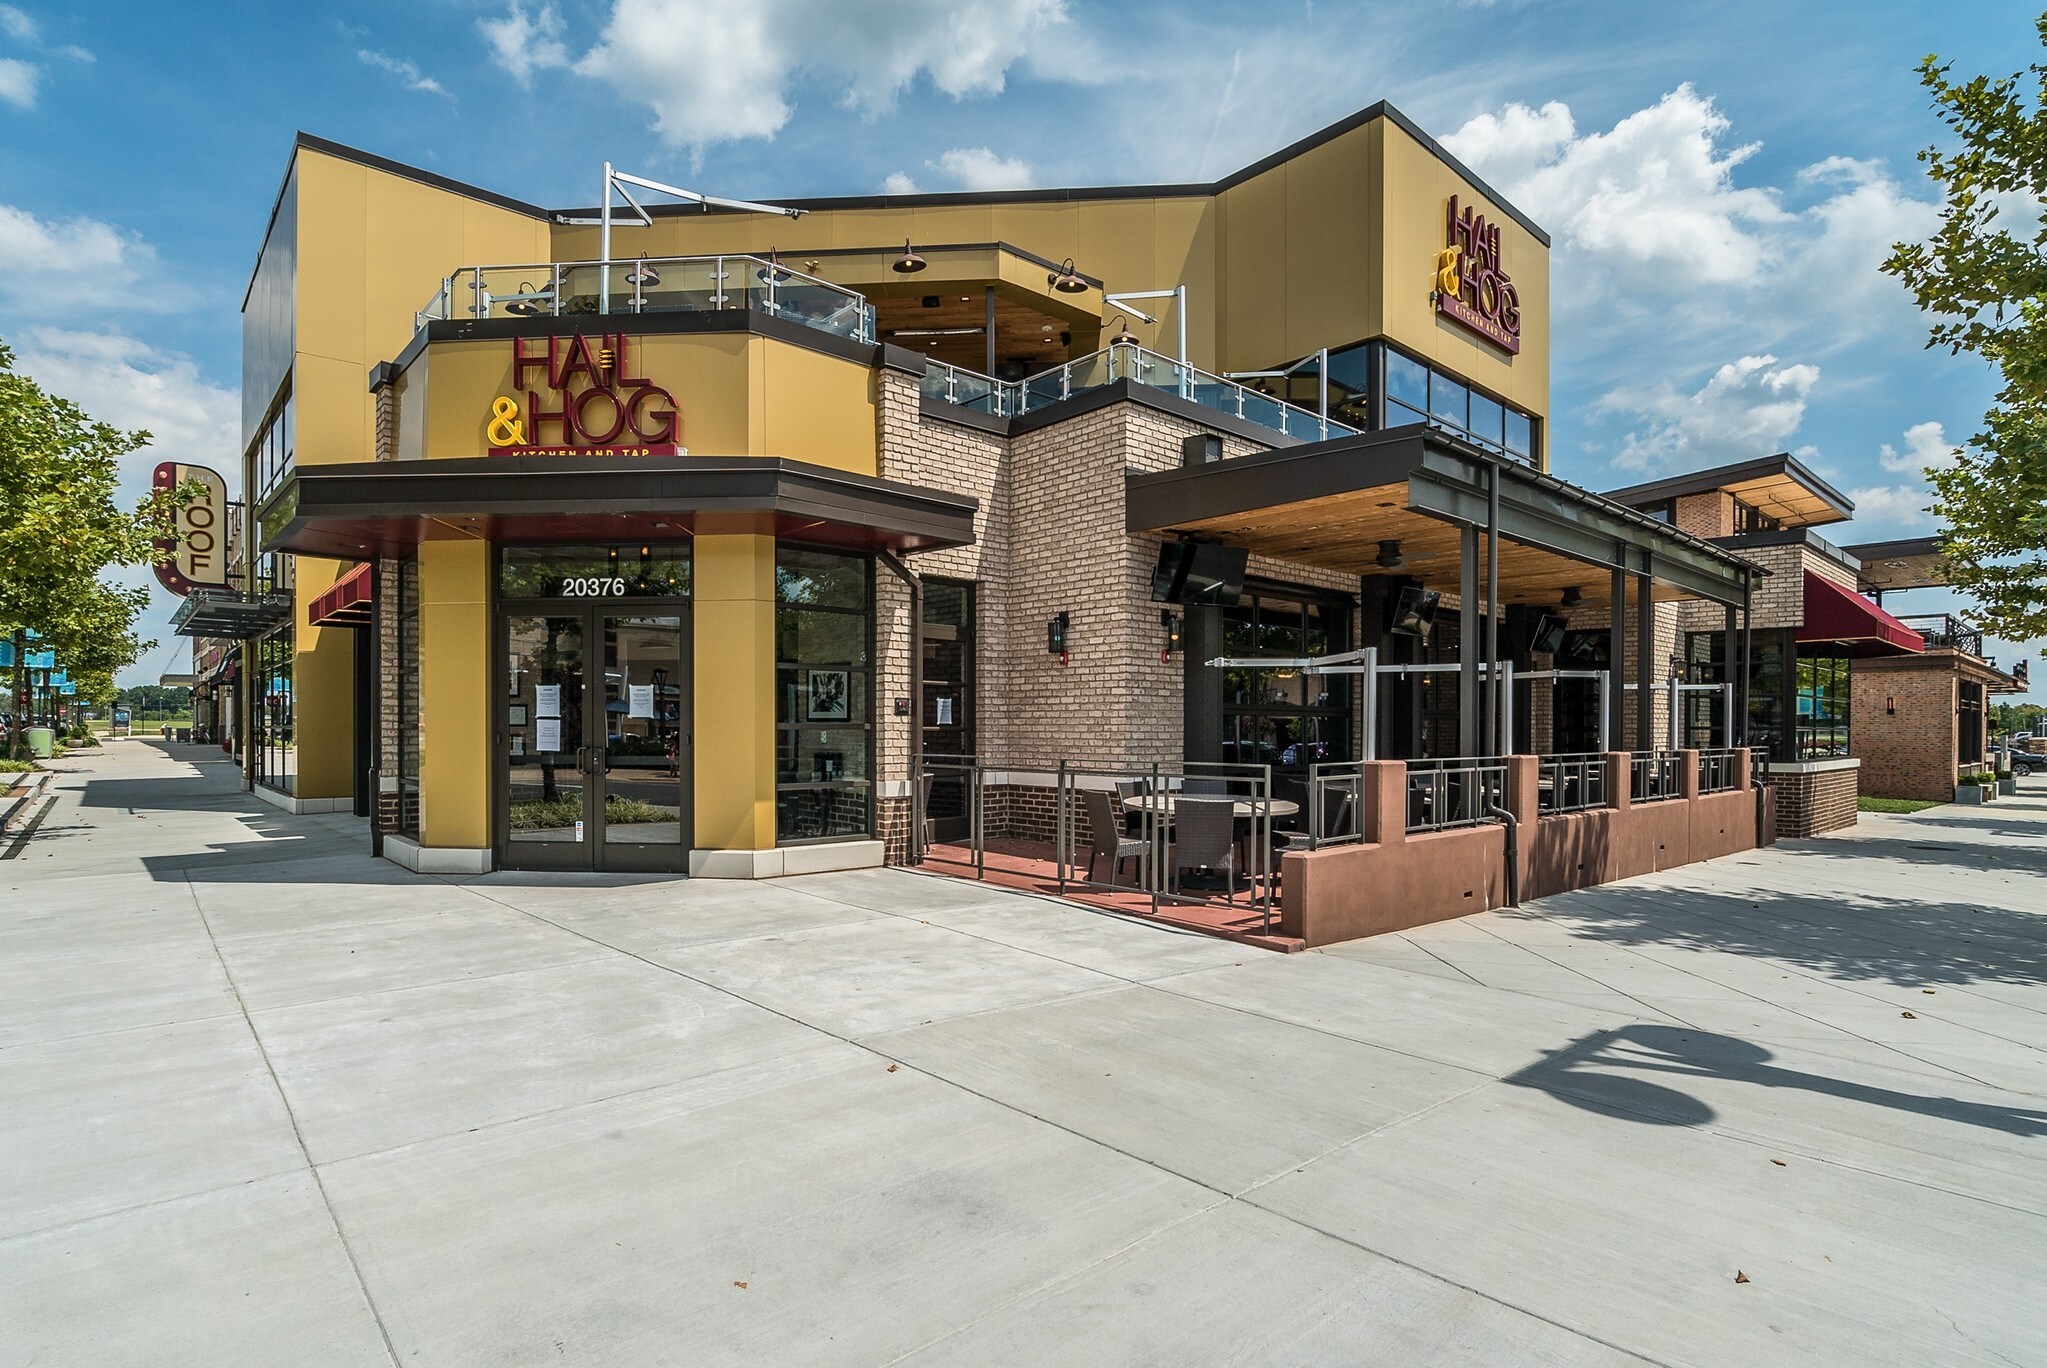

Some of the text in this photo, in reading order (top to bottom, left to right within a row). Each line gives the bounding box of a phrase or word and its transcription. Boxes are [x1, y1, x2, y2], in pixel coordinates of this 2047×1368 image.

[1449, 194, 1511, 283] HAIL
[1438, 247, 1521, 336] & HOG
[1455, 304, 1512, 344] KITCHEN AND TAP
[513, 332, 654, 391] HAIL
[486, 385, 680, 446] & HOG
[622, 448, 650, 457] TAP
[186, 473, 214, 483] THE
[562, 578, 625, 597] 20376
